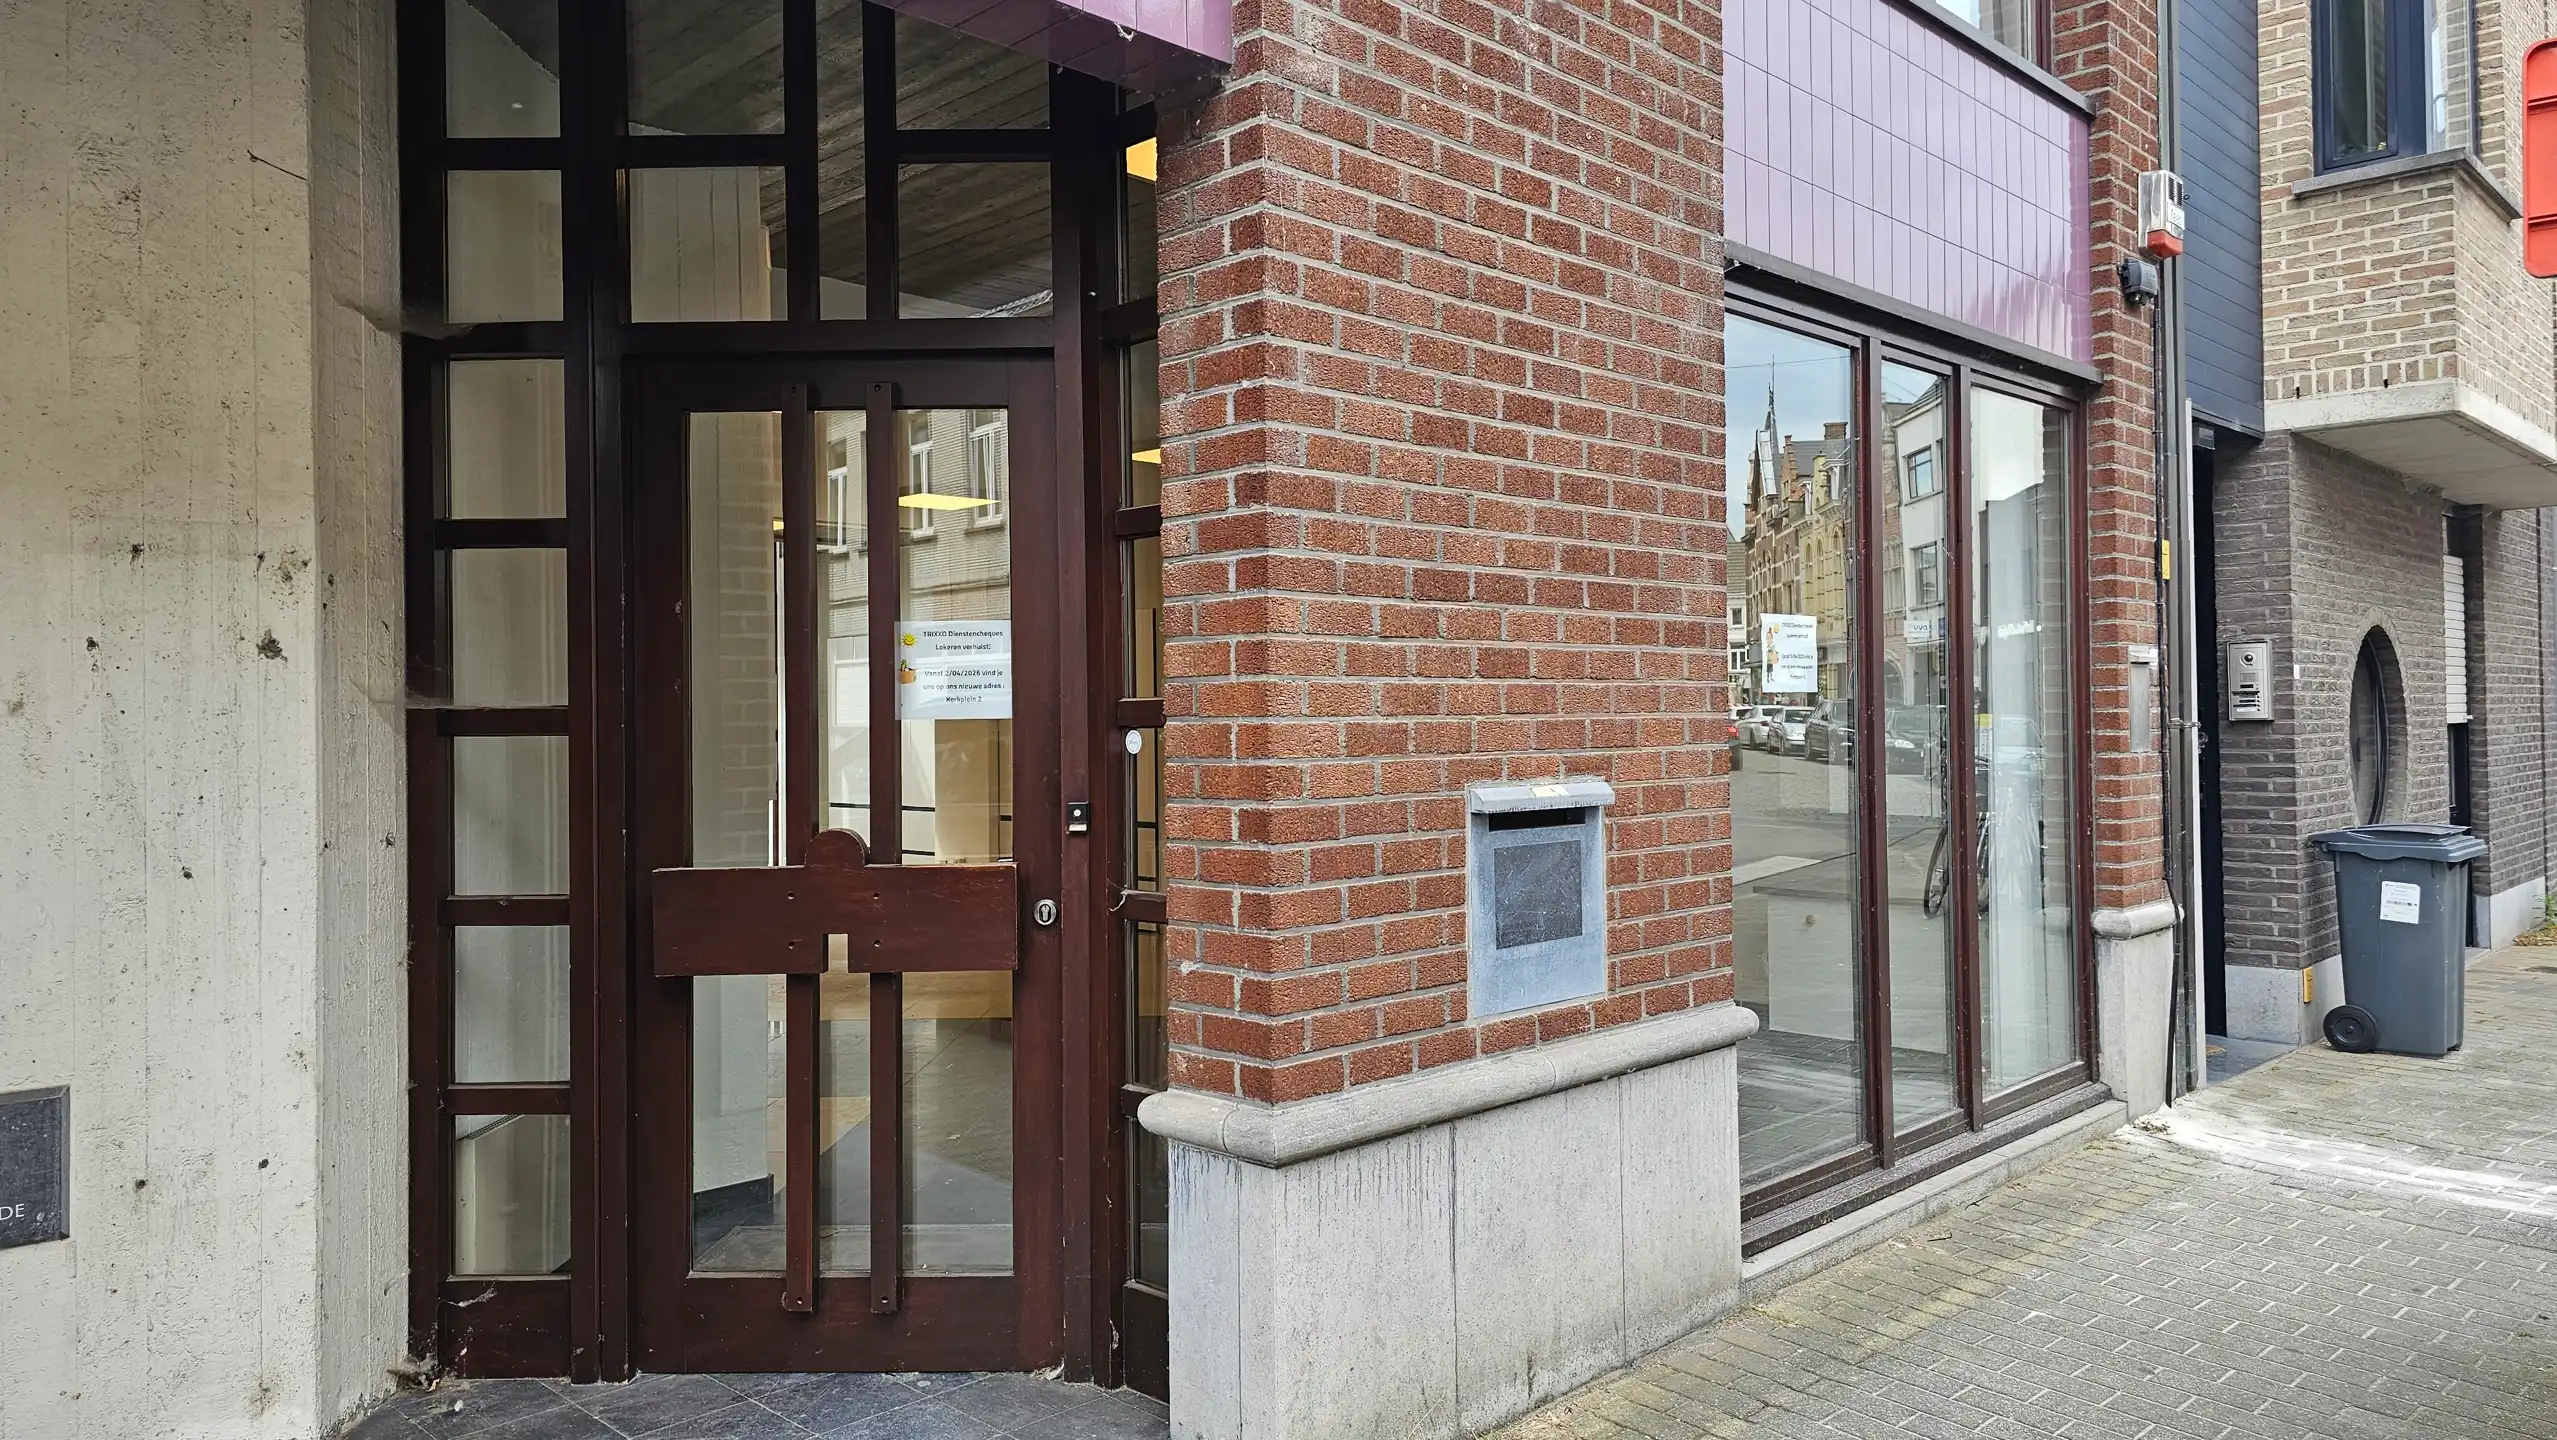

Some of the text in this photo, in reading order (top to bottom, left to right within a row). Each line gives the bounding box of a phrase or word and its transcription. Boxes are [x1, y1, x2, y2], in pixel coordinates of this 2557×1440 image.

[948, 630, 1003, 638] Dienstencheques
[996, 669, 1003, 677] je
[946, 696, 977, 704] Kerkplein
